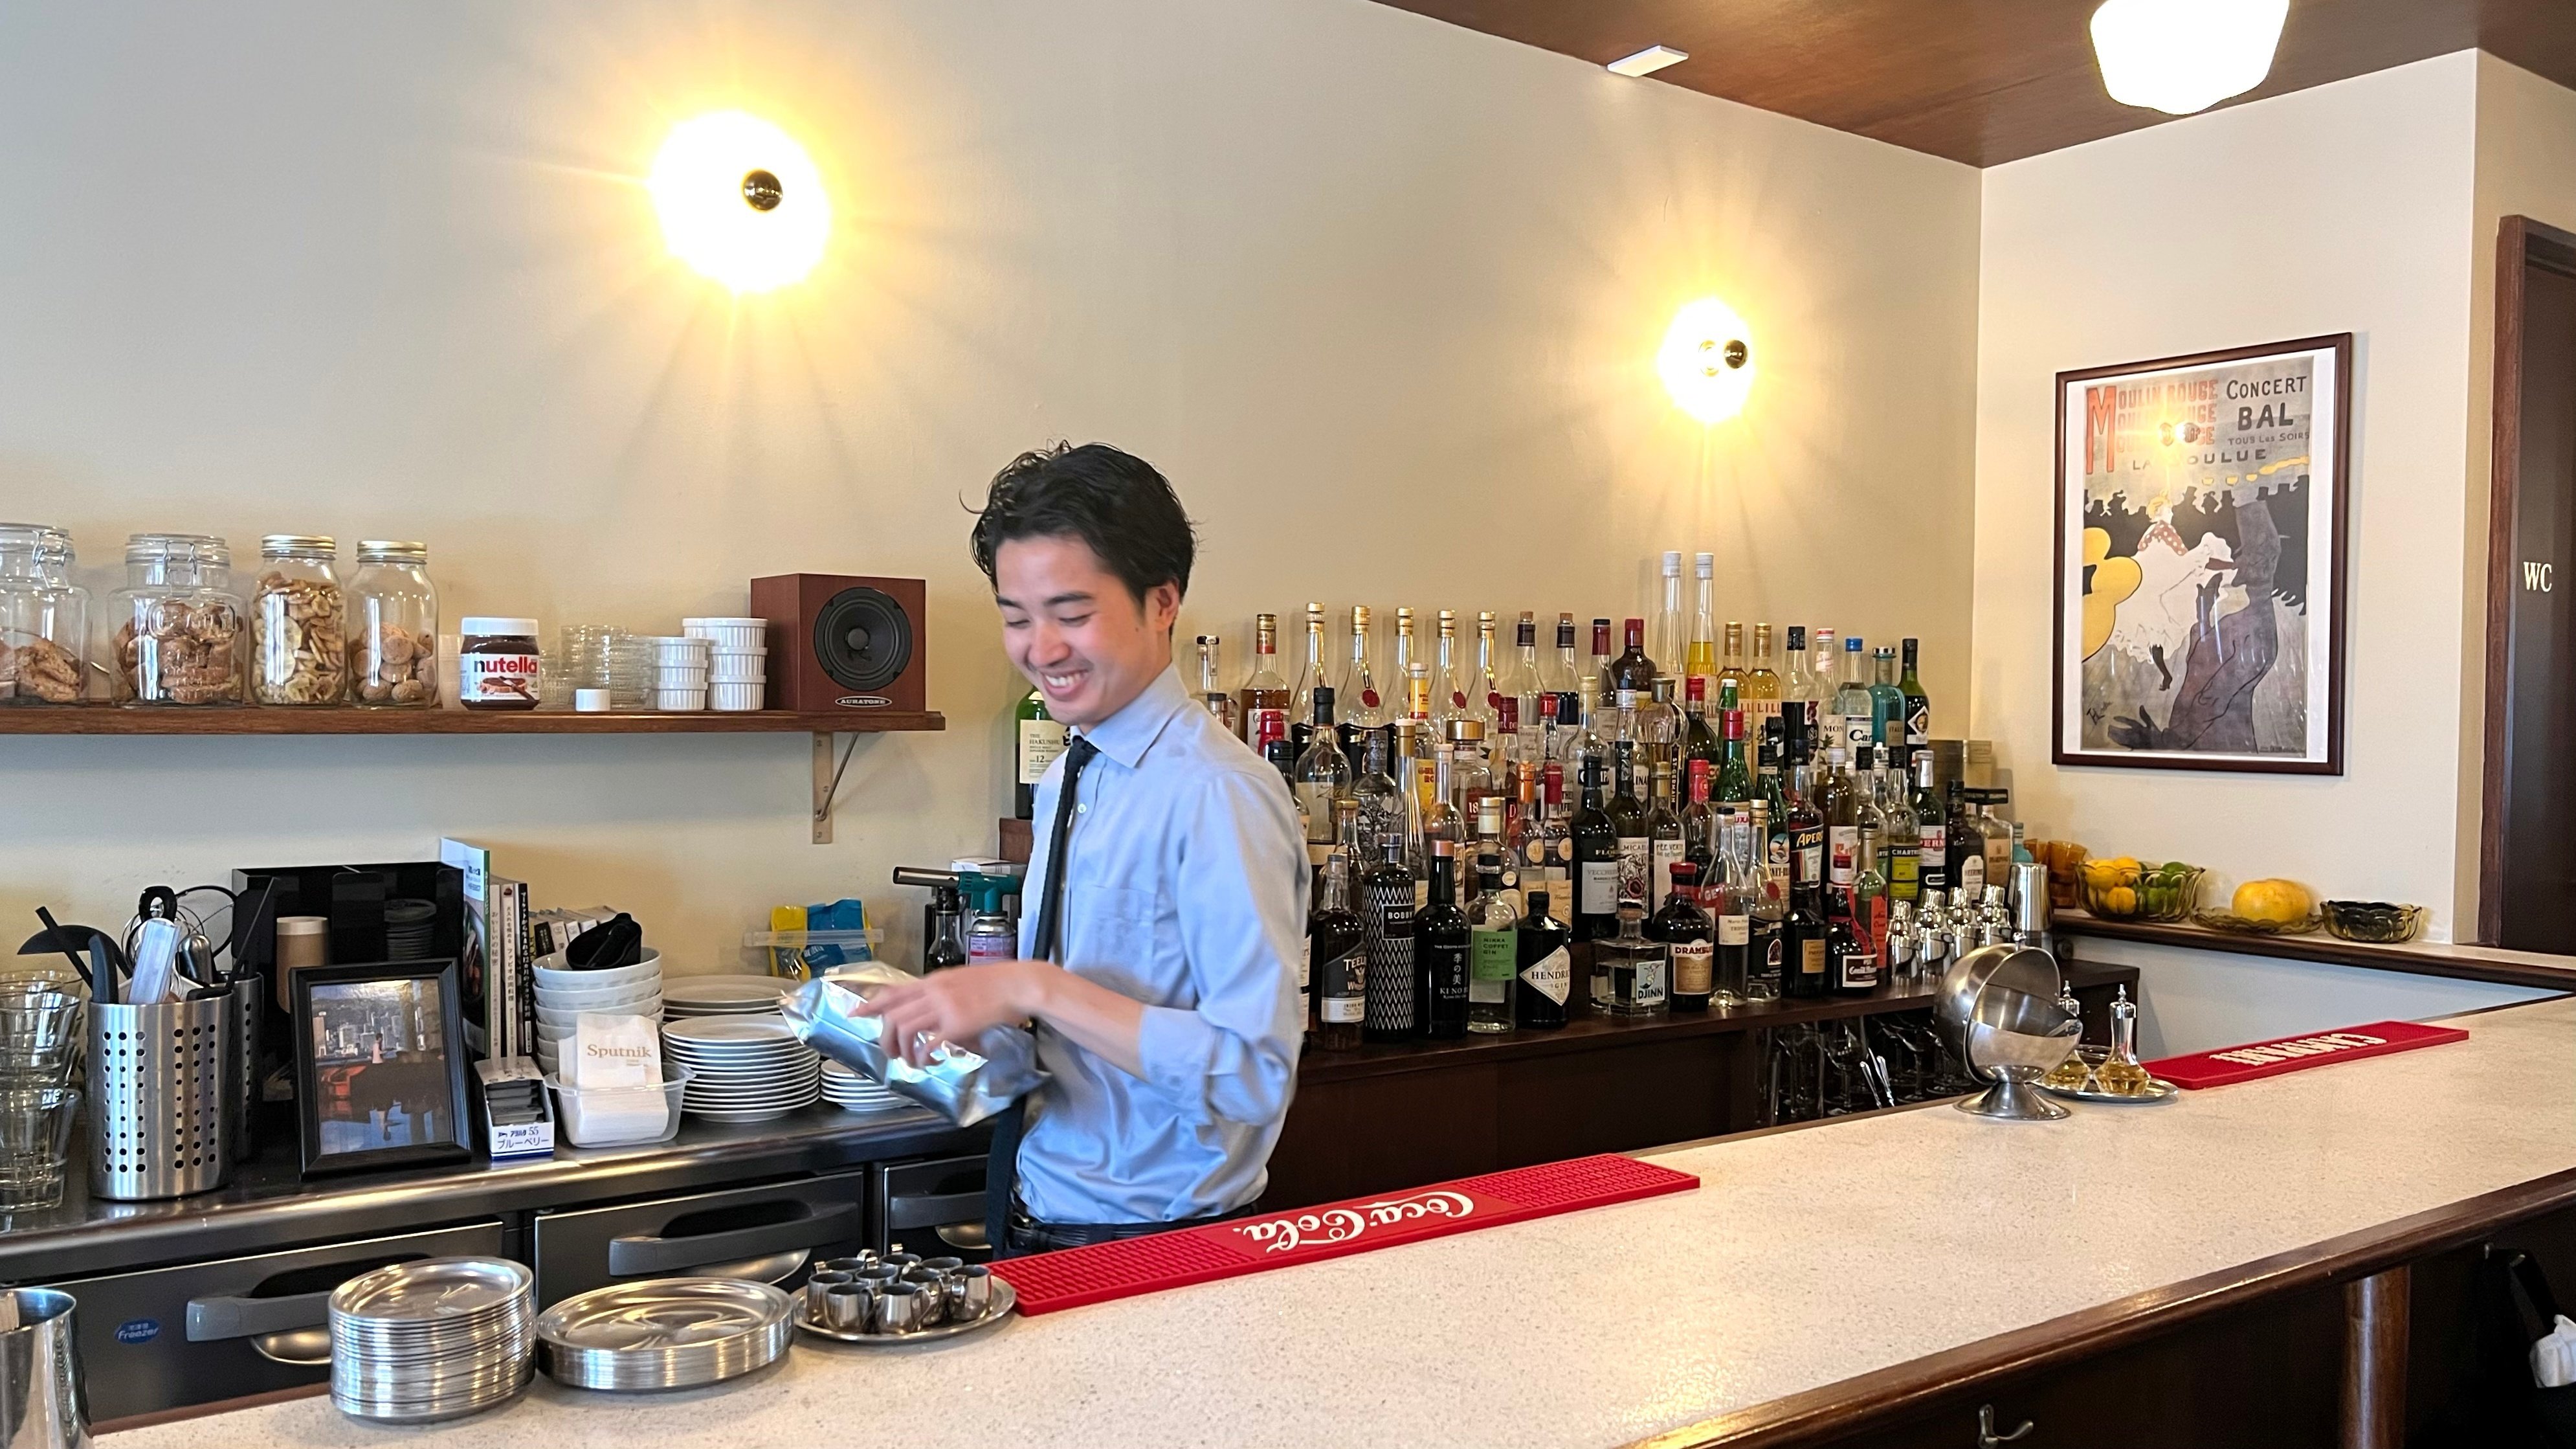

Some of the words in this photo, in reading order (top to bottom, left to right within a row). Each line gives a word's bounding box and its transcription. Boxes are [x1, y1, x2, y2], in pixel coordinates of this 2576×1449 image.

[2226, 376, 2308, 400] CONCERT
[2237, 402, 2294, 431] BAL
[2228, 436, 2256, 446] TOUS
[2279, 431, 2310, 442] SOIRS
[2523, 561, 2553, 592] WC
[473, 656, 538, 674] nutella
[1036, 754, 1045, 763] 12
[1920, 839, 1946, 848] PERN
[1638, 987, 1663, 1000] DJINN
[586, 1044, 652, 1059] Sputnik
[528, 1126, 539, 1136] 55
[497, 1136, 550, 1150] ブルーベリー
[1242, 1190, 1474, 1253] Coca-Cola
[118, 1327, 159, 1340] Freezer
